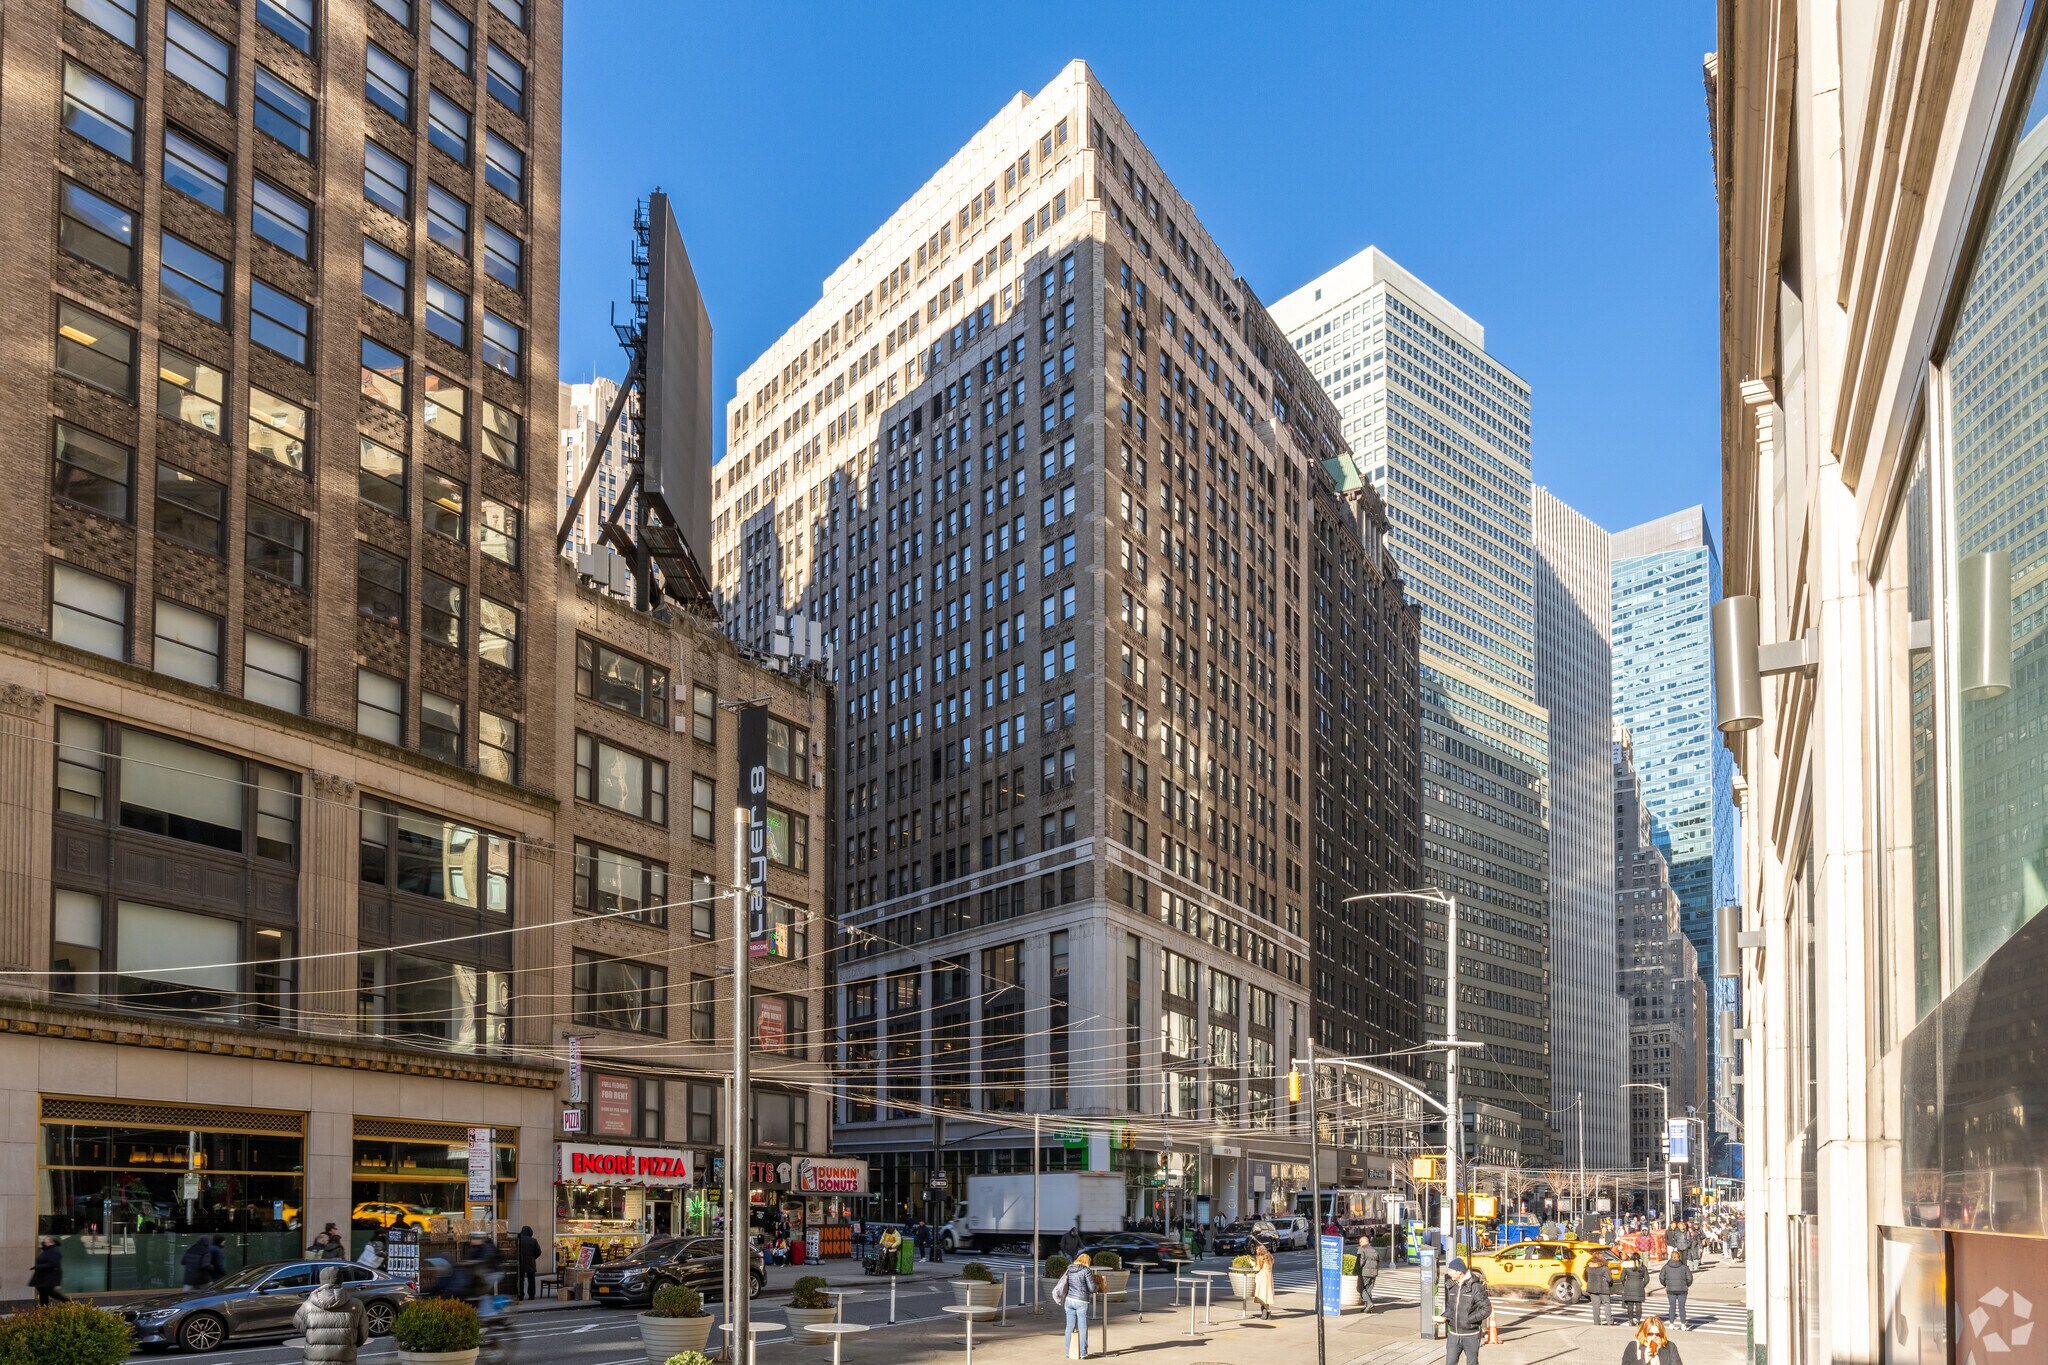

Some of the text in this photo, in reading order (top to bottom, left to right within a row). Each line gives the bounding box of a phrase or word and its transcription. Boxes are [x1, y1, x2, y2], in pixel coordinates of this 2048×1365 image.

[751, 765, 767, 938] Layer 8
[601, 1090, 628, 1100] FOR RENT
[564, 1112, 580, 1129] PIZZA
[572, 1153, 686, 1177] ENCORE PIZZA
[818, 1166, 860, 1179] DUNKIN'
[749, 1162, 775, 1184] FTS
[818, 1179, 858, 1191] DONUTS
[420, 1193, 433, 1206] W
